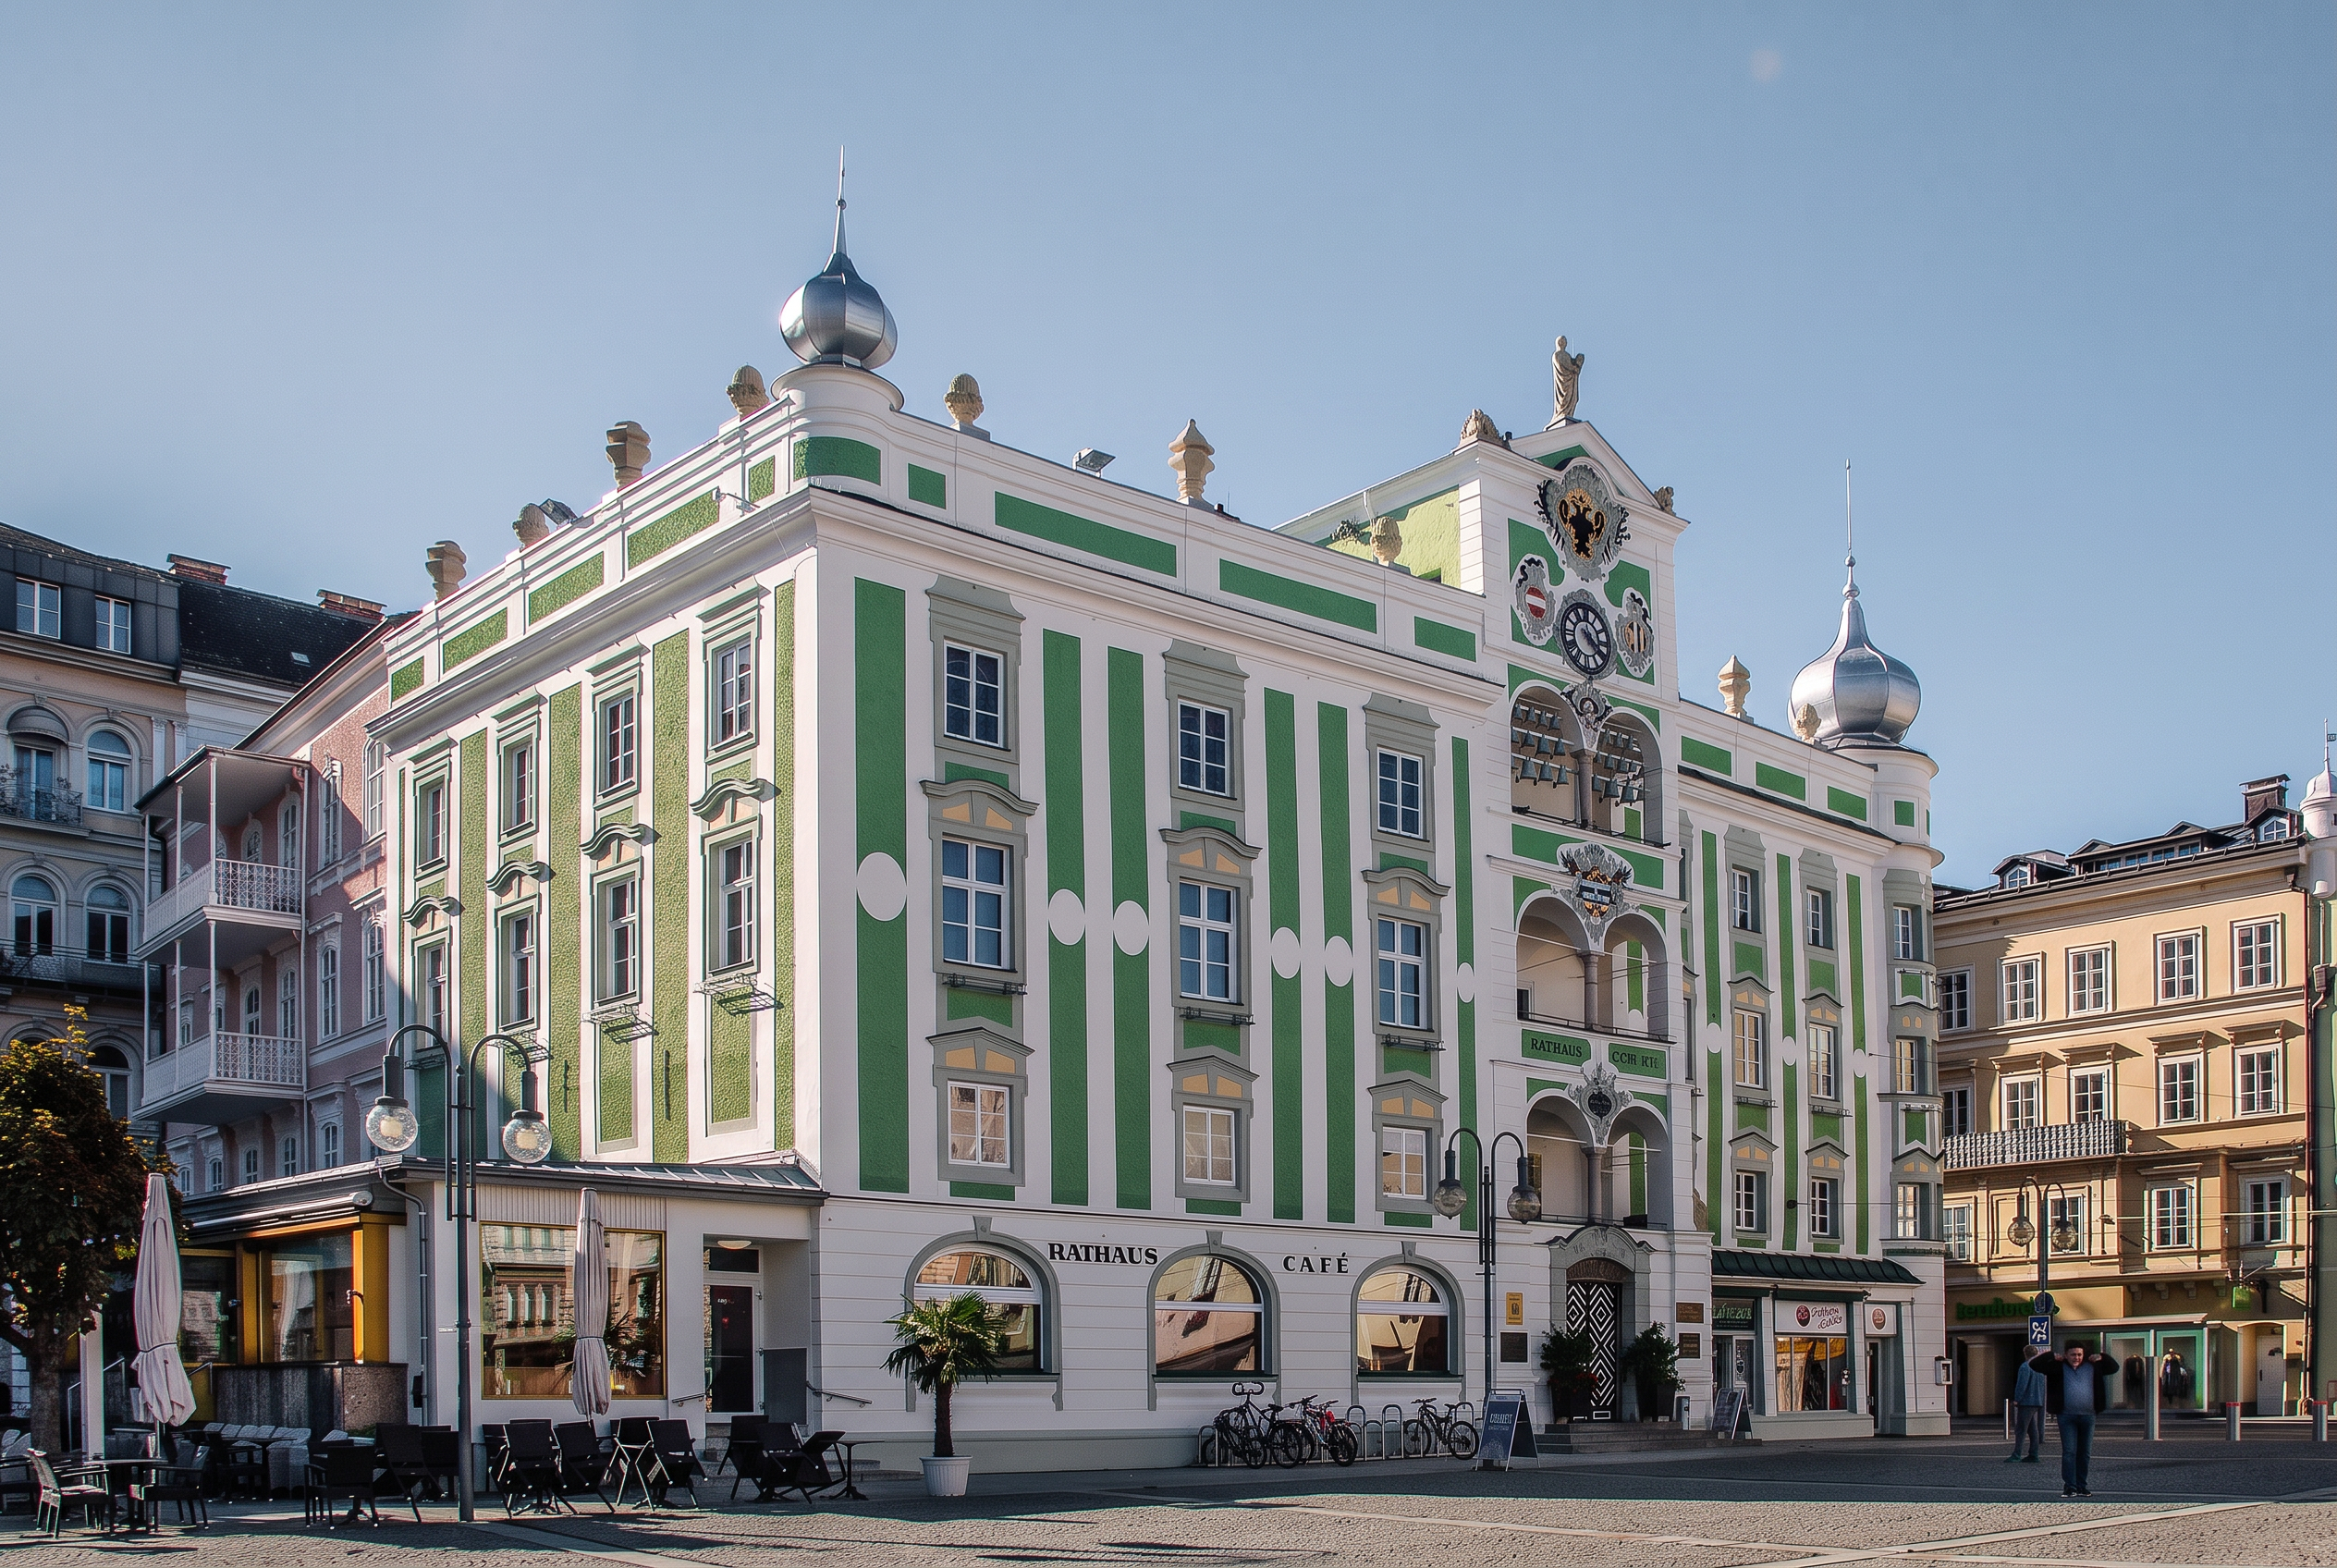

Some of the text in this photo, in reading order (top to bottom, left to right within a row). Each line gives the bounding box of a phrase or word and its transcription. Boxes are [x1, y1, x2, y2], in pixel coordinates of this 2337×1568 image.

[1530, 1037, 1583, 1058] RATHAUS
[1047, 1242, 1350, 1274] RATHAUS CAFÉ
